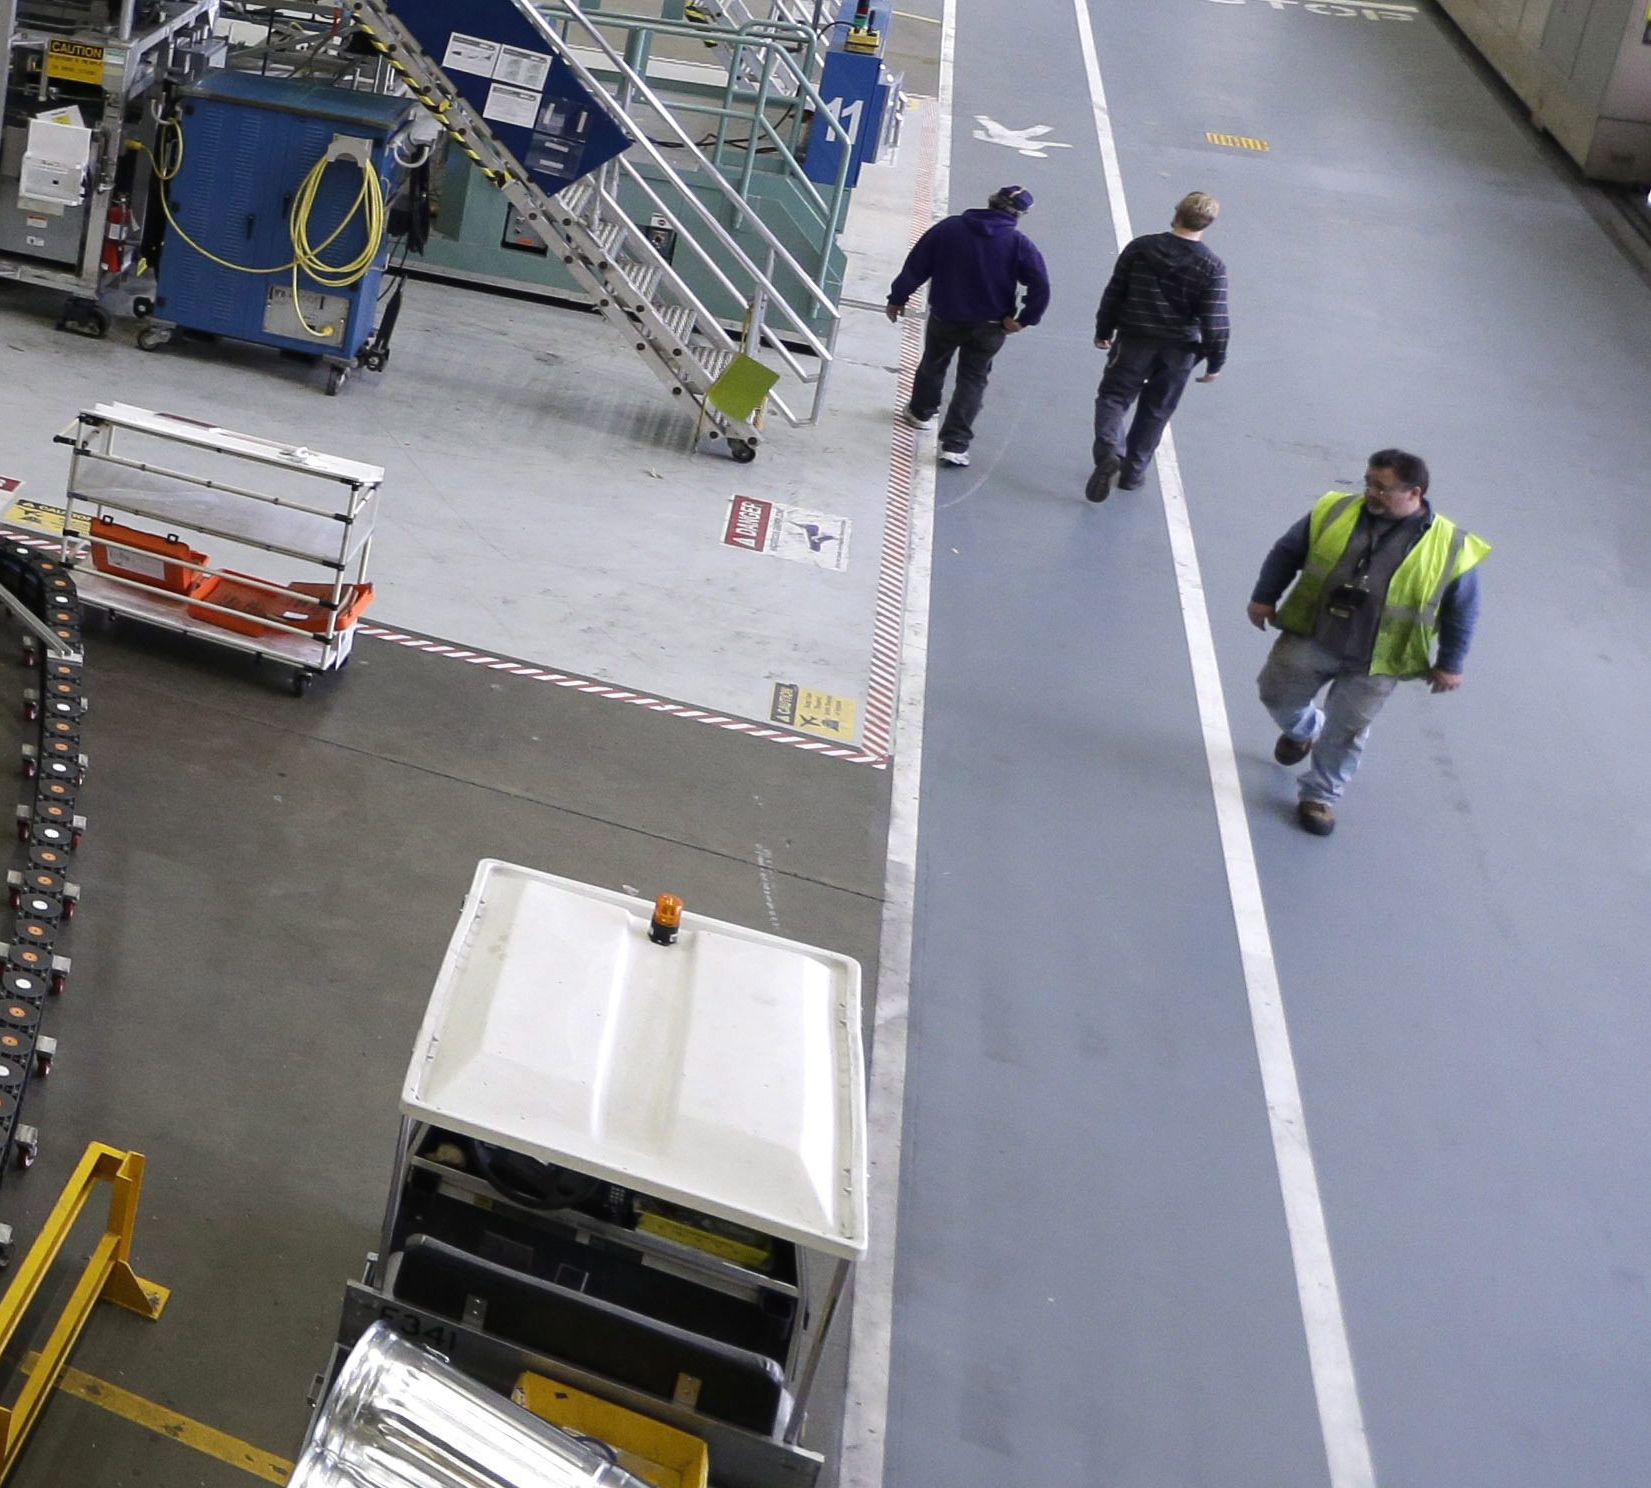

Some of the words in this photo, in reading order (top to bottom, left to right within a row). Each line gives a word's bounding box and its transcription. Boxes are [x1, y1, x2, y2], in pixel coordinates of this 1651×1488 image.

[51, 41, 103, 59] CAUTION
[825, 96, 865, 145] 11
[735, 500, 764, 536] DANGER
